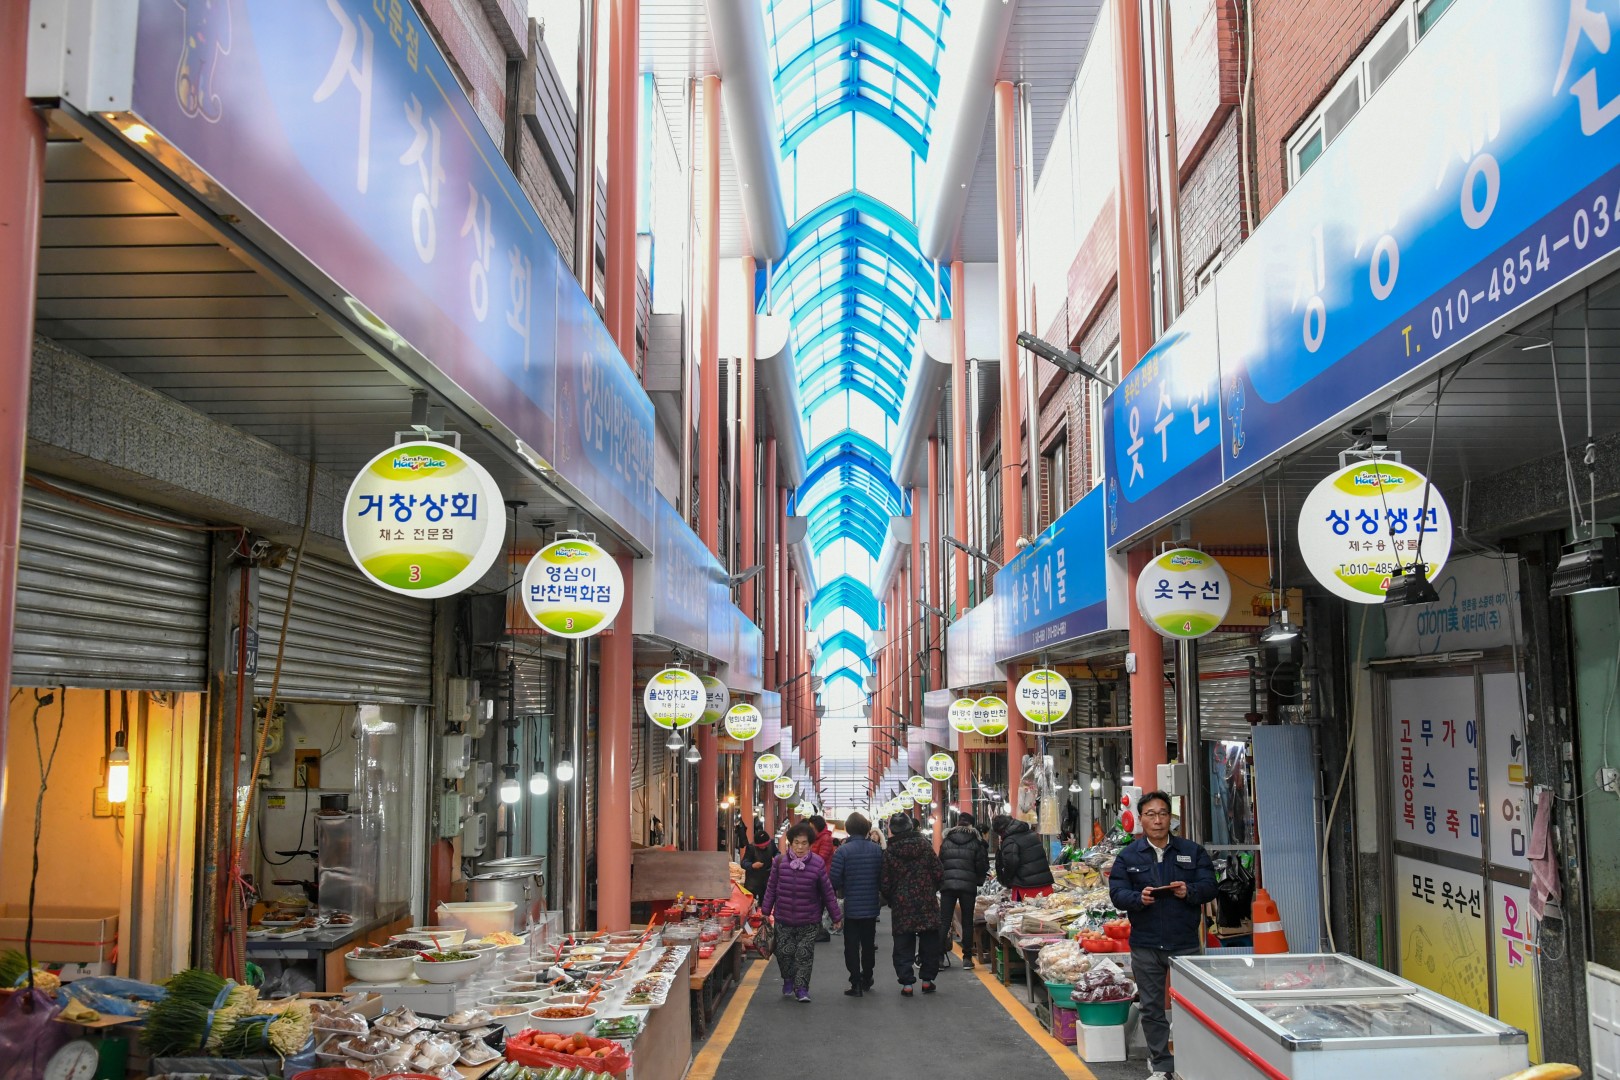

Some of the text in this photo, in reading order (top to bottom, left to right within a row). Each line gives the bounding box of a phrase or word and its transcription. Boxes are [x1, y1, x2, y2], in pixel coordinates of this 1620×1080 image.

[312, 0, 533, 372] 거창상회
[1126, 378, 1211, 488] 옷수선
[358, 492, 478, 523] 거창상회
[1325, 507, 1438, 536] 싱싱생선
[379, 527, 454, 541] 채소 전문점
[1348, 539, 1419, 552] 제수용 생물
[408, 566, 421, 582] 3
[545, 566, 597, 583] 영심이
[531, 584, 611, 603] 반찬백화점
[1012, 547, 1067, 625] 반송건어물
[1154, 579, 1220, 600] 옷수선
[566, 618, 574, 629] 3
[1182, 620, 1191, 632] 4
[649, 688, 699, 701] 울산정자젓갈
[1022, 687, 1066, 699] 반송건어물
[1411, 874, 1481, 919] 모든 옷수선
